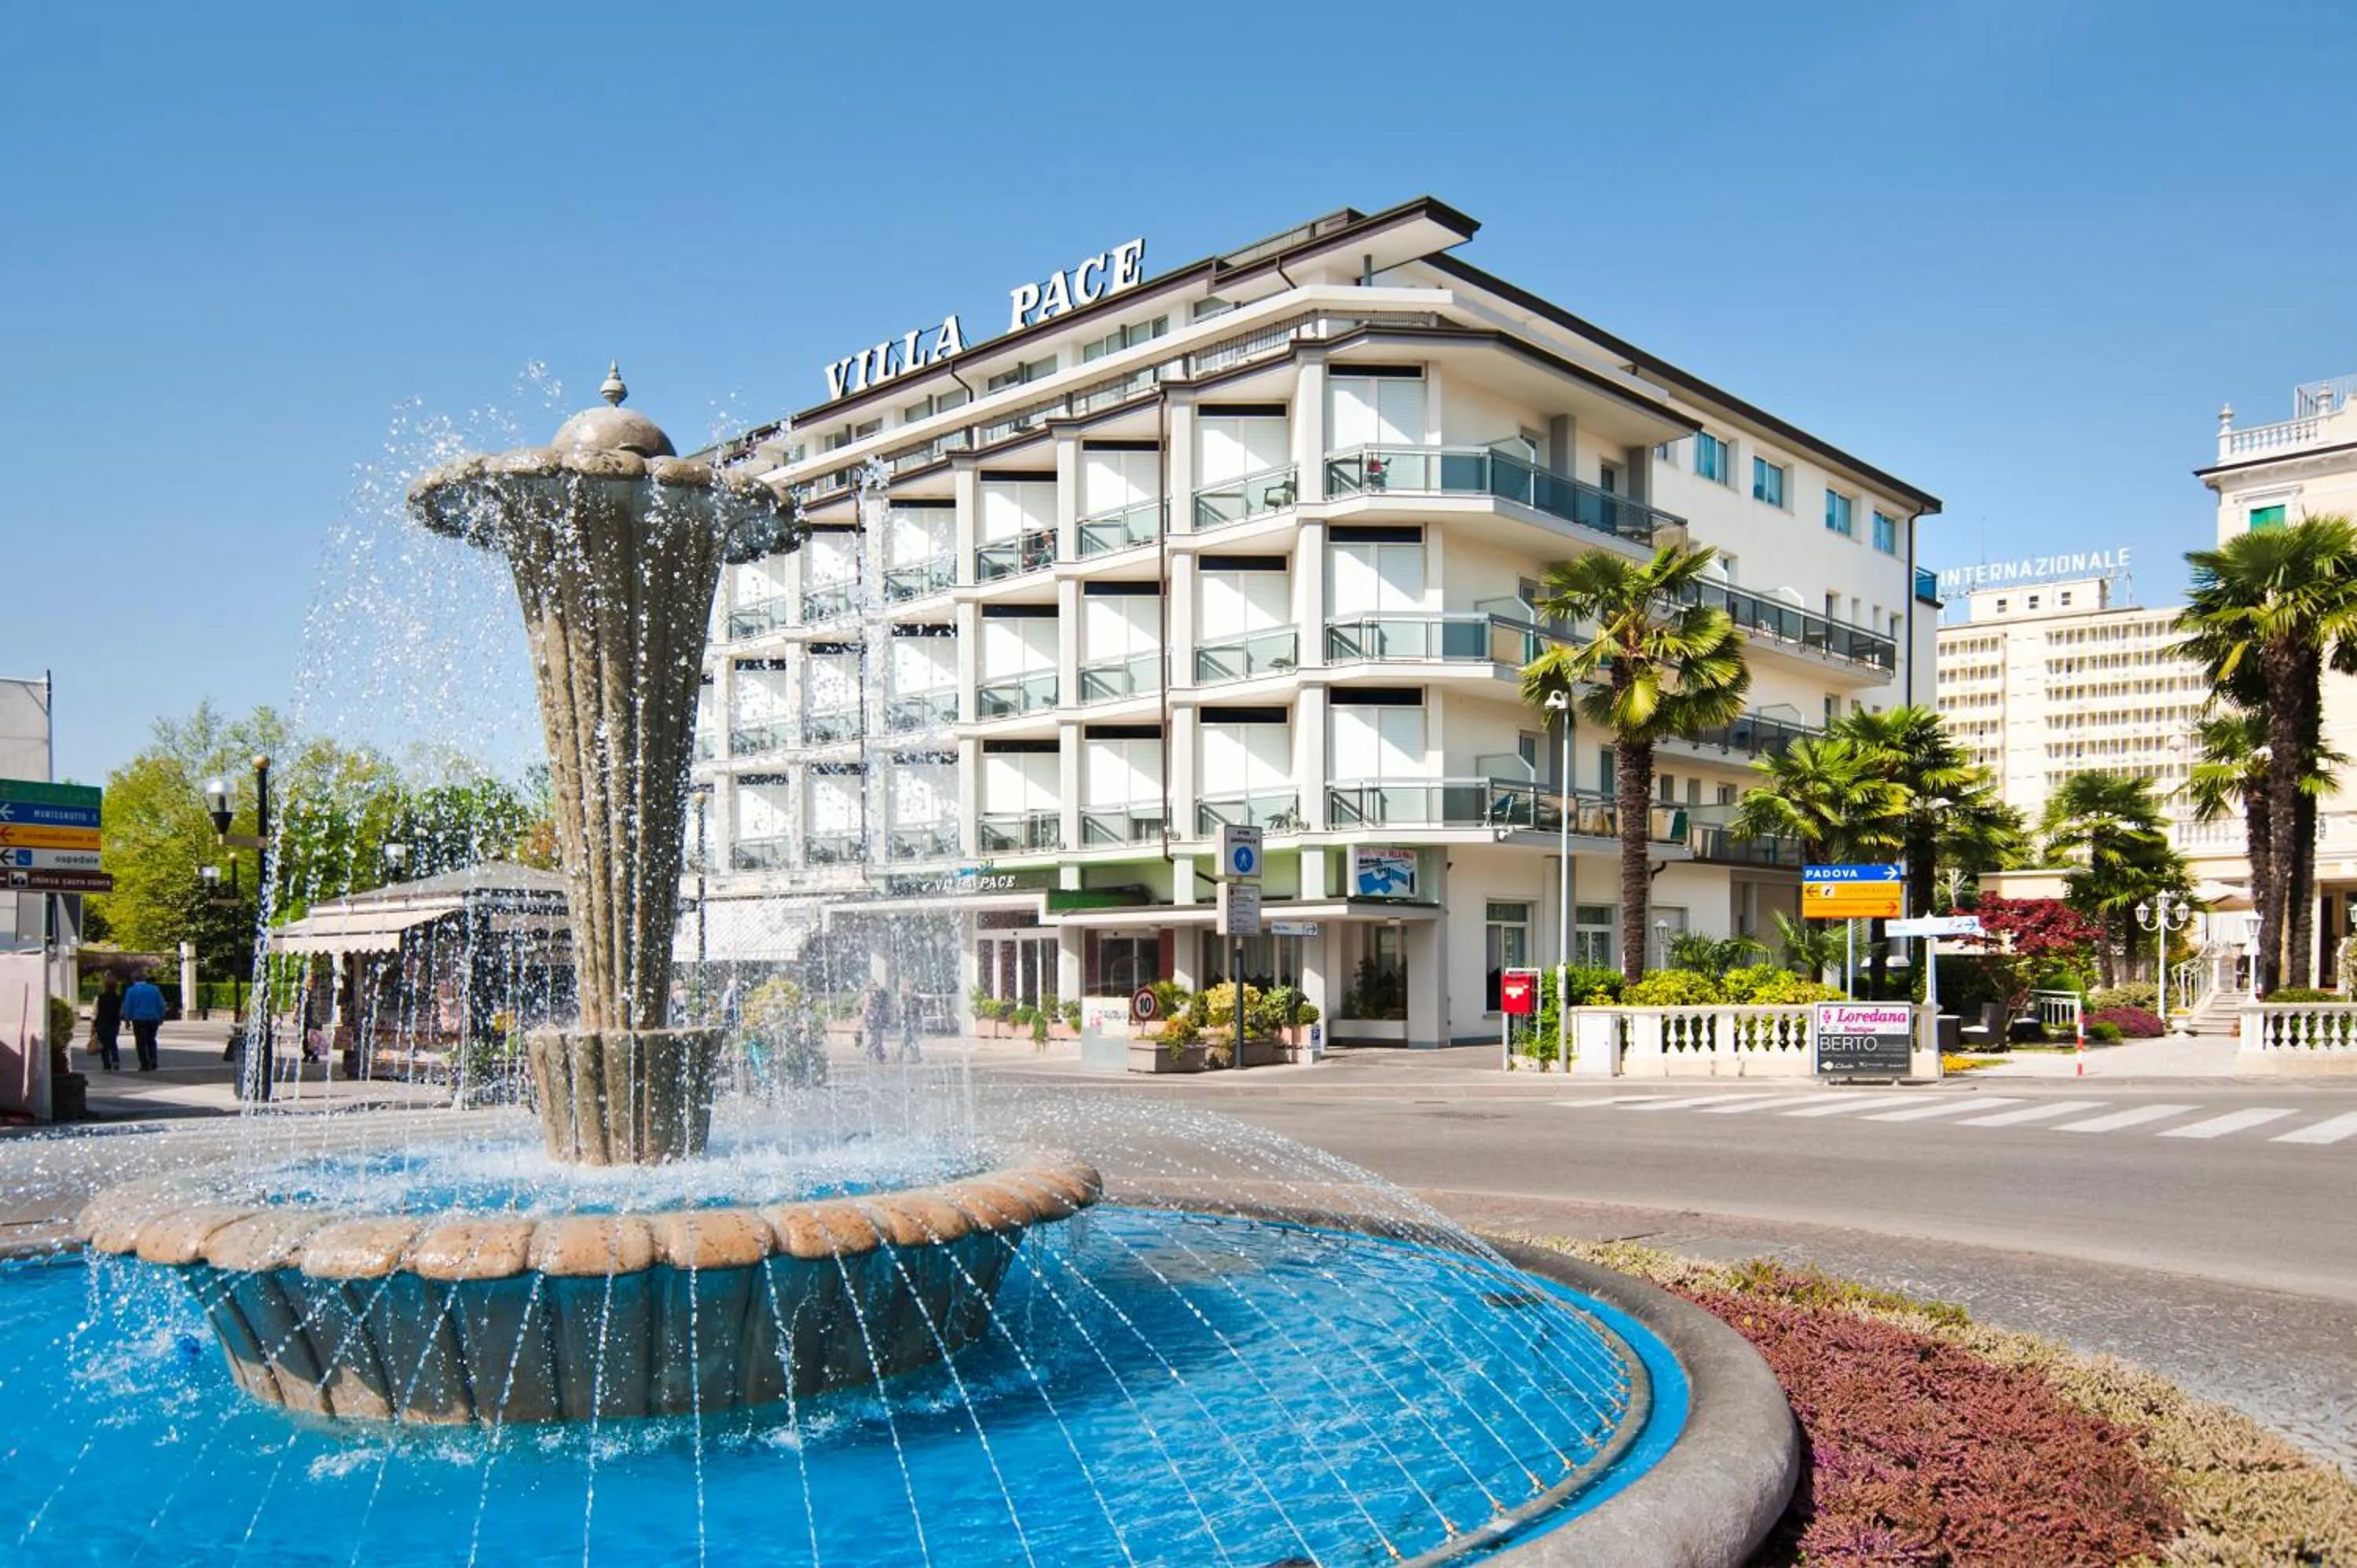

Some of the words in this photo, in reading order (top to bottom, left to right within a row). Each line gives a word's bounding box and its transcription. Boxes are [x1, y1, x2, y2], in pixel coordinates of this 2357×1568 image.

[825, 314, 965, 400] VILLA
[1006, 238, 1145, 334] PACE
[1938, 548, 2132, 586] INTERNAZIONALE
[54, 854, 99, 864] ospedale
[1805, 870, 1858, 878] PADOVA
[980, 875, 1016, 889] PACE
[1139, 997, 1152, 1013] 10
[1836, 1009, 1908, 1023] Loredana
[1820, 1036, 1878, 1051] BERTO
